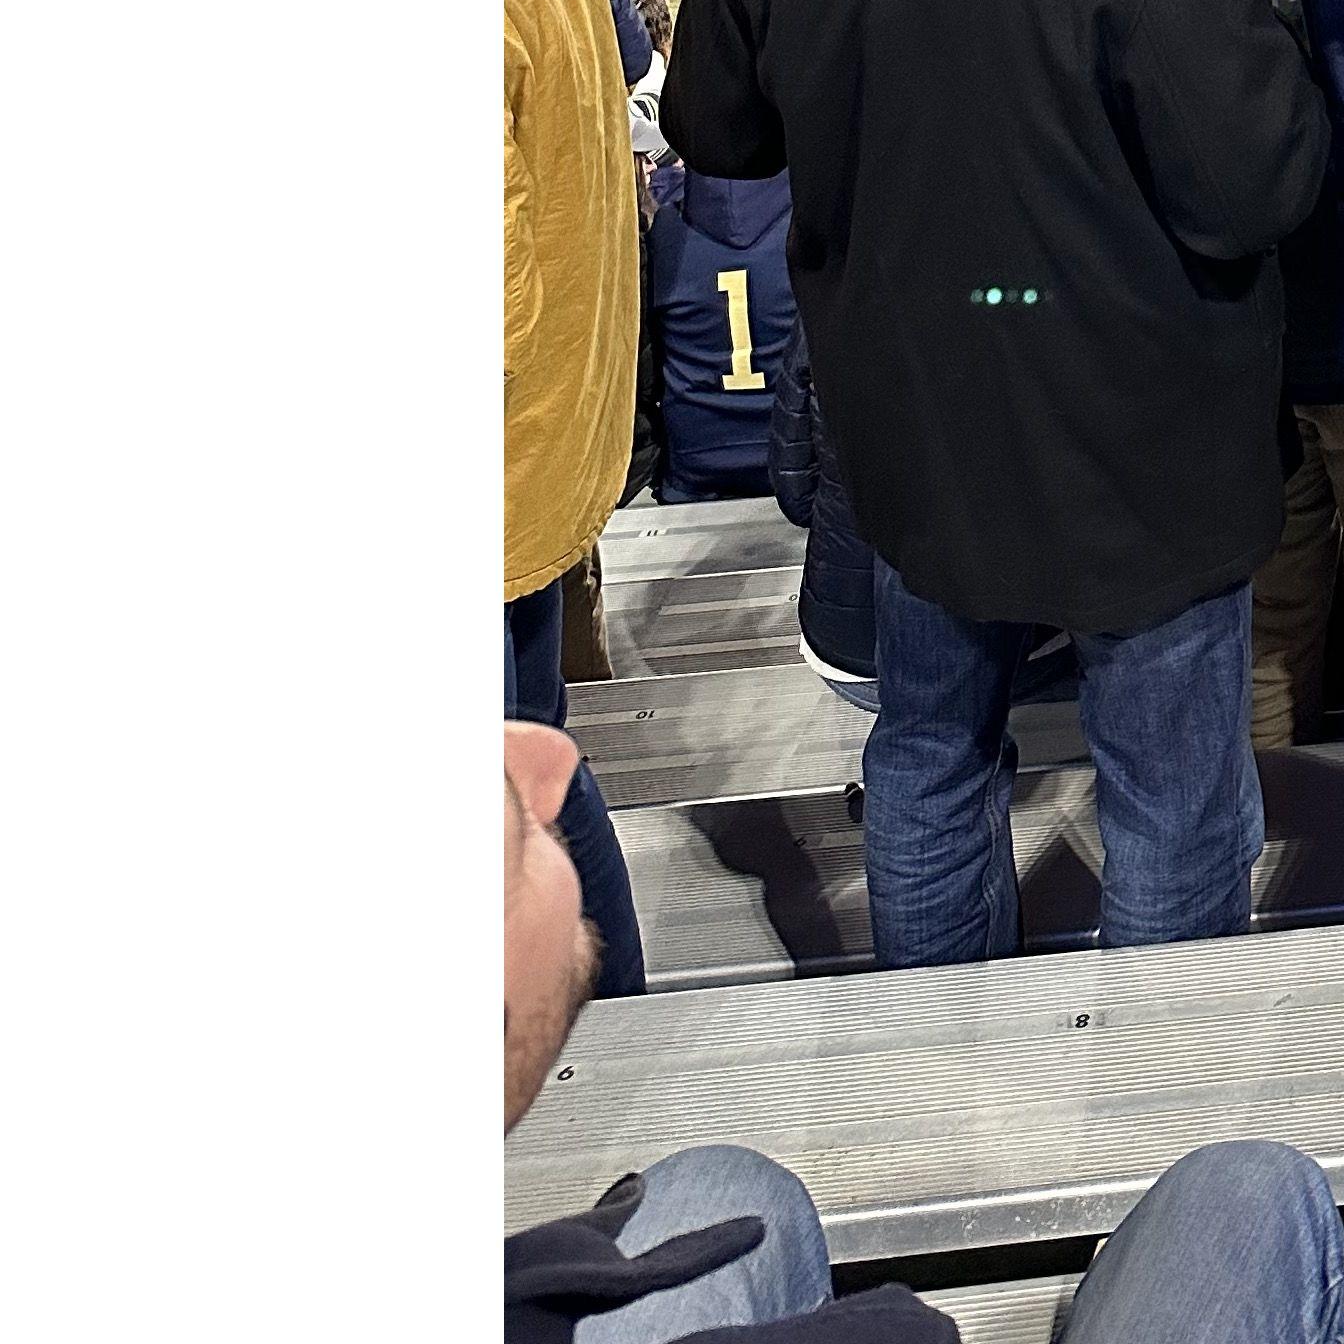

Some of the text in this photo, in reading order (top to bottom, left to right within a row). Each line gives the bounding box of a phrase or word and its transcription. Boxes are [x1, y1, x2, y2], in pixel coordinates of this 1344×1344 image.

[716, 269, 766, 391] 1
[635, 709, 655, 720] 10
[1074, 1013, 1091, 1029] 8
